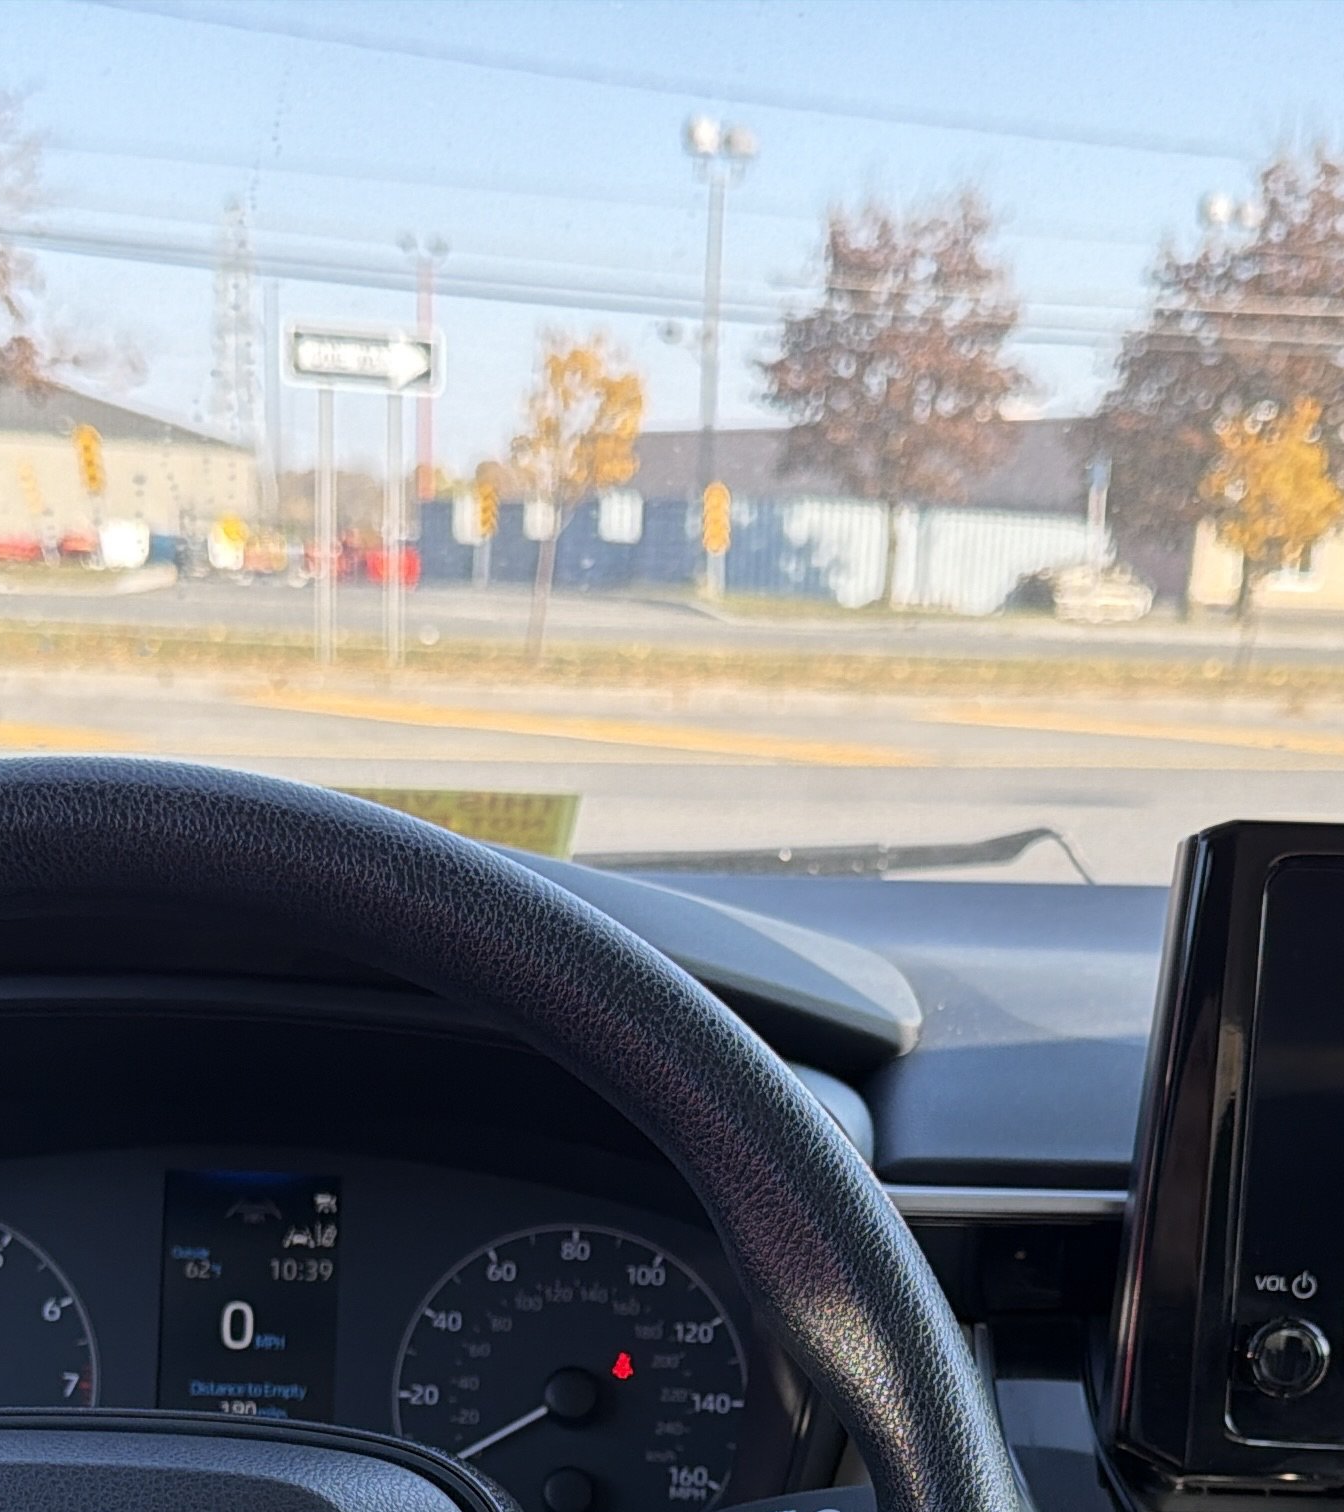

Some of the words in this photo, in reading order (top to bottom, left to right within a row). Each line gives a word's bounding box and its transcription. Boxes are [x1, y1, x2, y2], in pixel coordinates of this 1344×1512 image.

[560, 1240, 591, 1262] 80
[269, 1257, 334, 1282] 10:39
[486, 1259, 518, 1283] 60
[626, 1263, 666, 1287] 100
[1254, 1274, 1288, 1292] VOL
[41, 1296, 61, 1322] 6
[220, 1300, 256, 1351] 0
[432, 1310, 463, 1333] 40
[674, 1321, 716, 1345] 120
[61, 1370, 81, 1398] 7
[408, 1383, 440, 1406] 20
[691, 1392, 732, 1415] 140
[668, 1465, 709, 1488] 160
